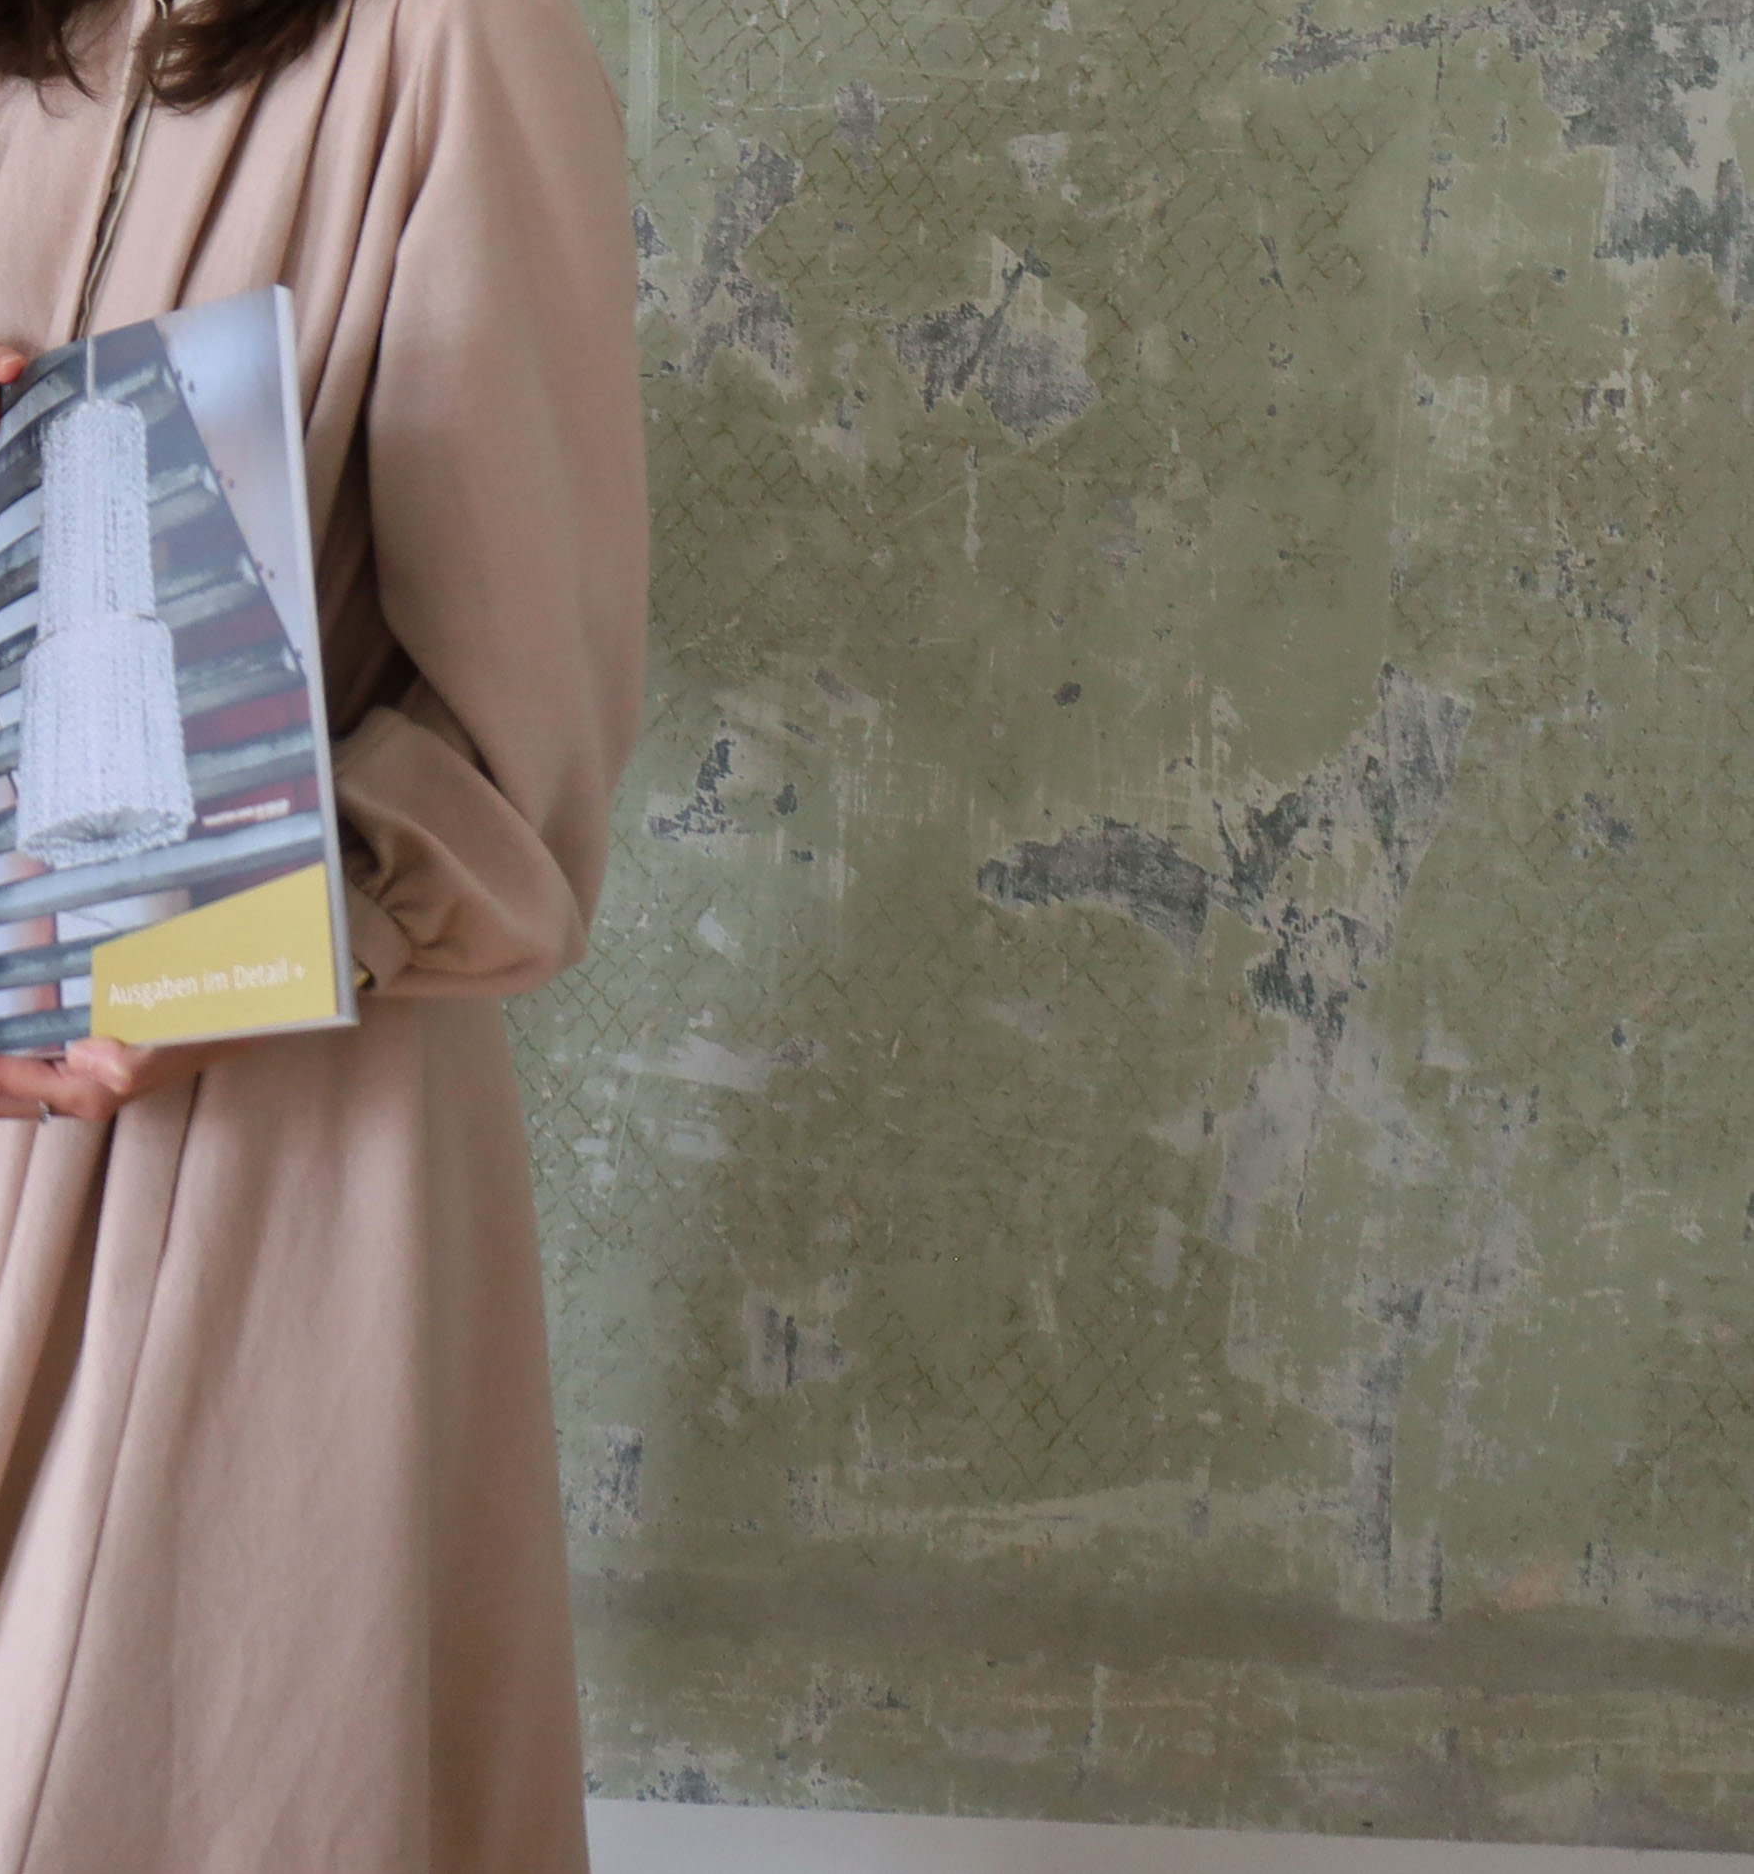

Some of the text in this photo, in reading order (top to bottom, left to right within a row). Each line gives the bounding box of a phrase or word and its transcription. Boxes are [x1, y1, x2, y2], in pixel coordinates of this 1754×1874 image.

[108, 956, 290, 1011] Ausgaben im Detail
